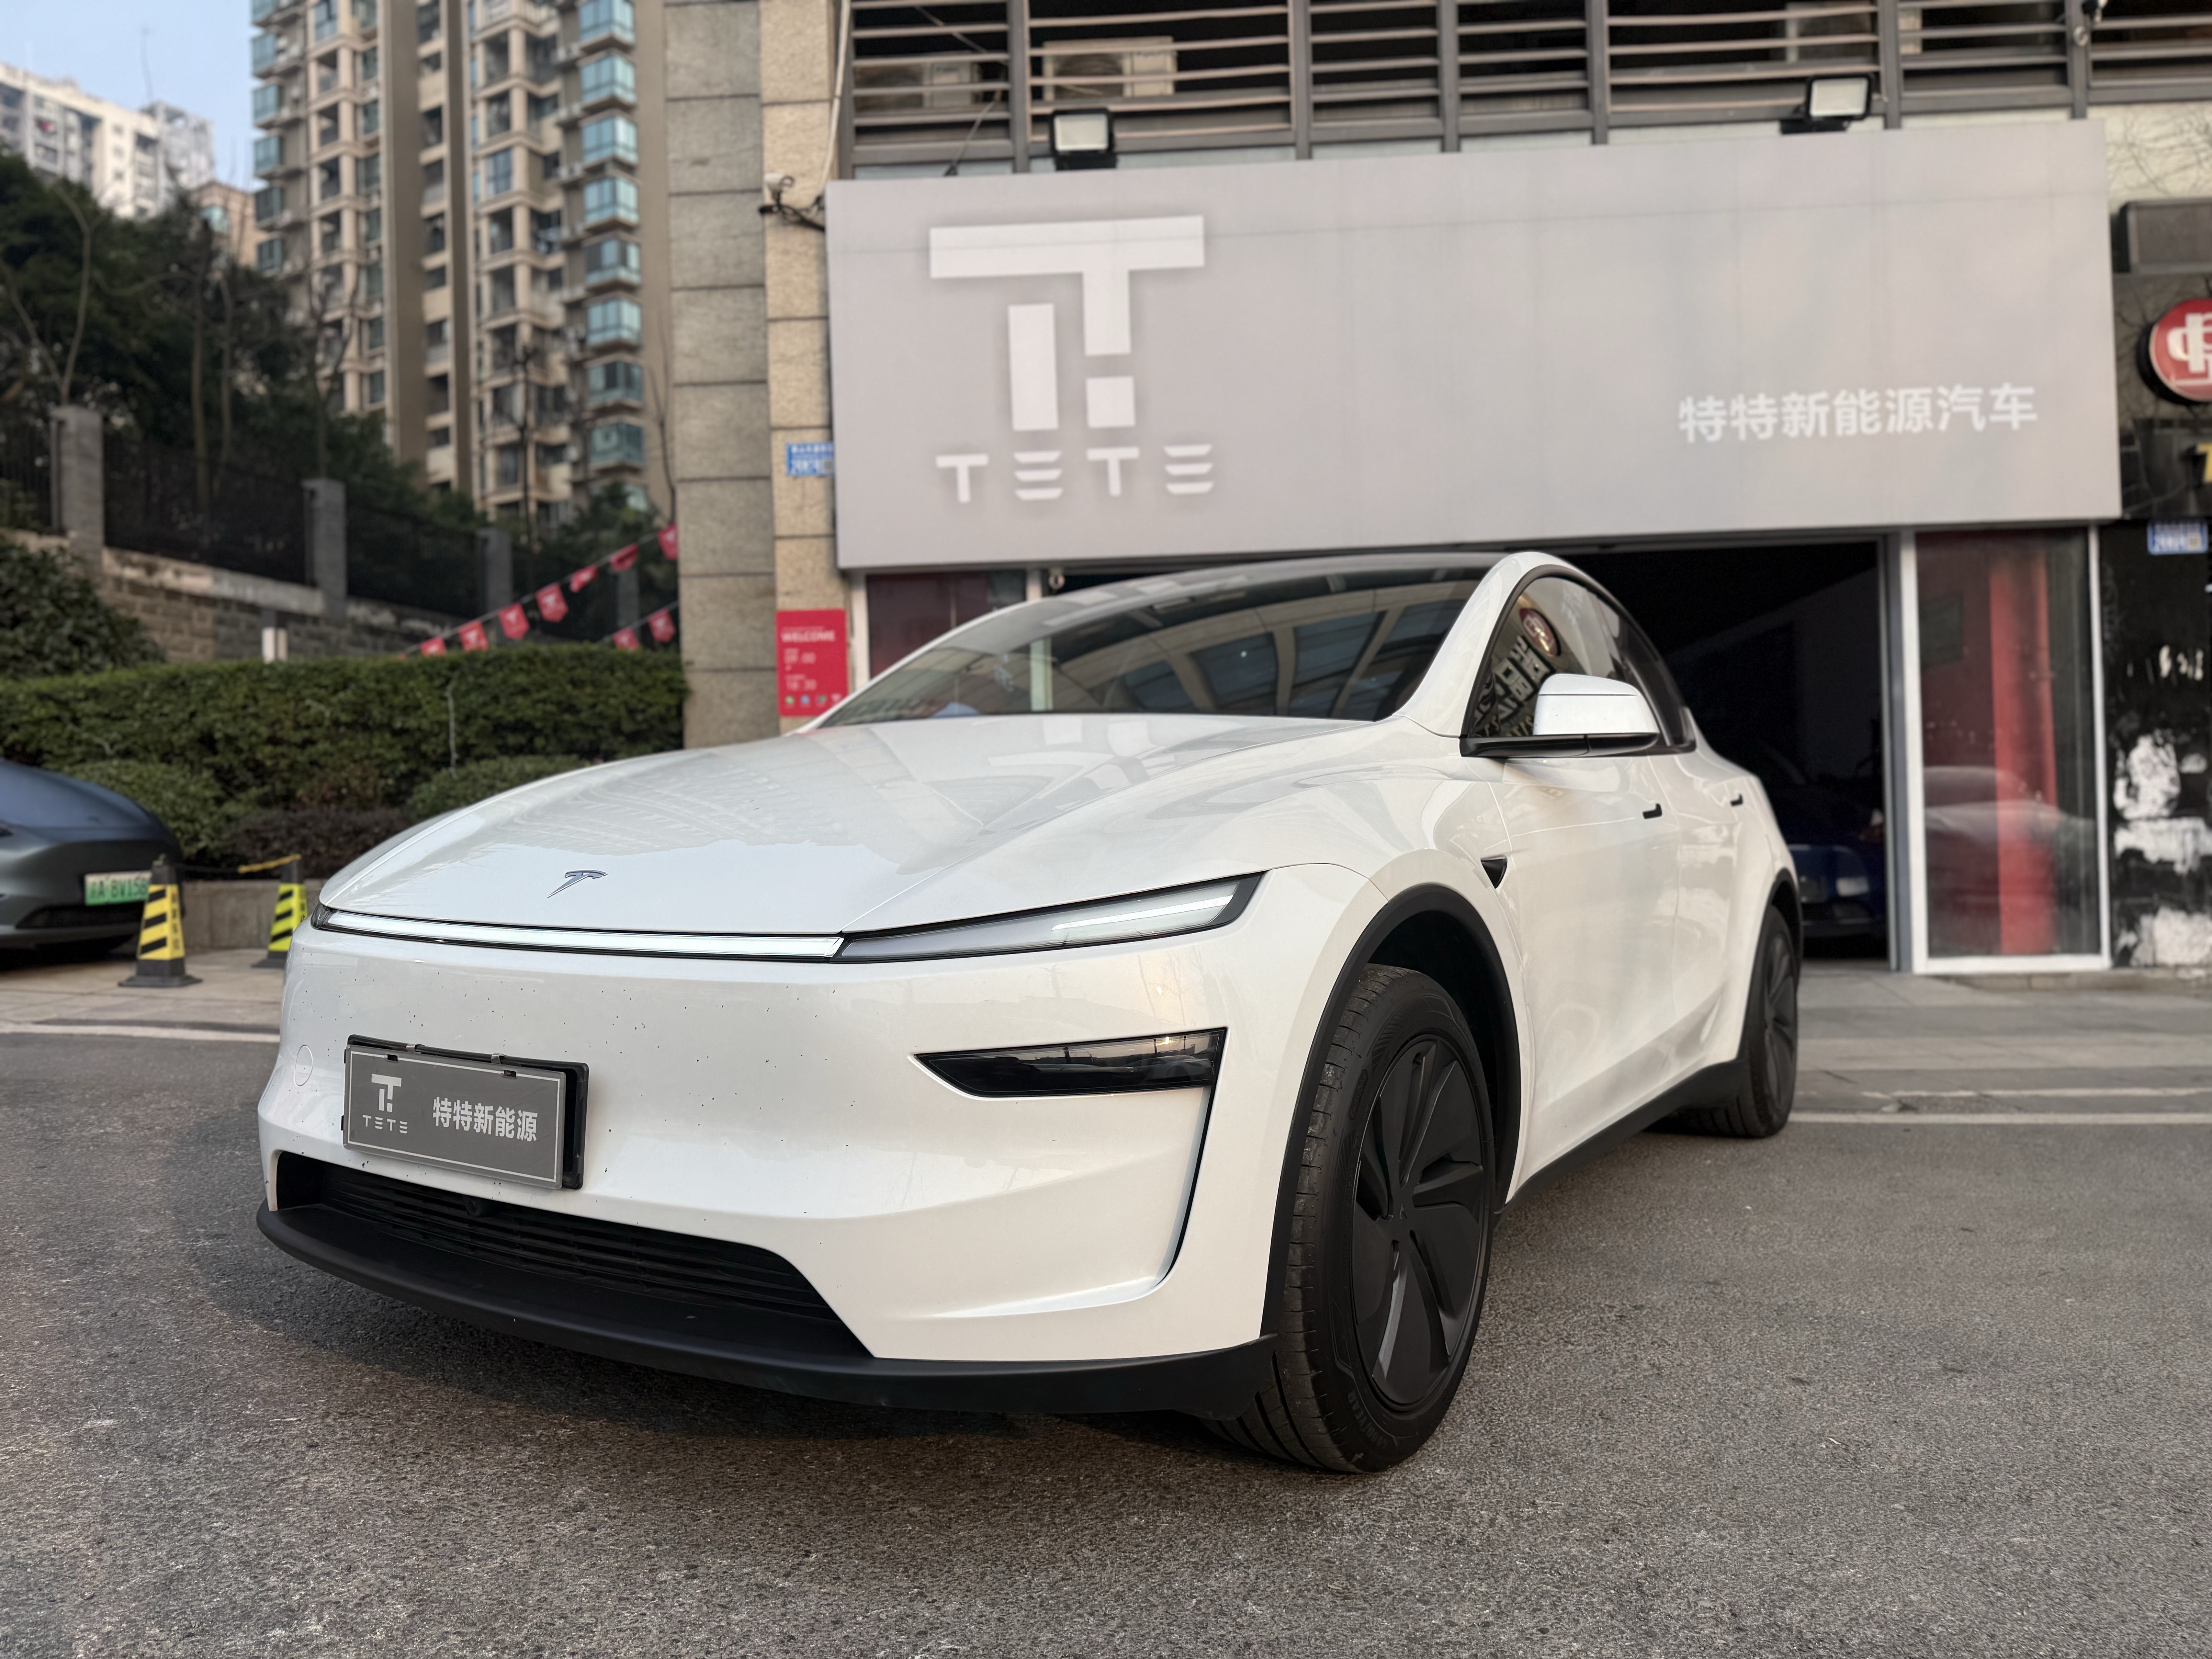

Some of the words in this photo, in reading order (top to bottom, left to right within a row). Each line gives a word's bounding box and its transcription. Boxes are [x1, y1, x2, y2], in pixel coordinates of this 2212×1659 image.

[1678, 383, 2038, 443] 特特新能源汽车
[936, 444, 1214, 503] TETE
[362, 1114, 408, 1134] TETE
[432, 1096, 538, 1142] 特特新能源
